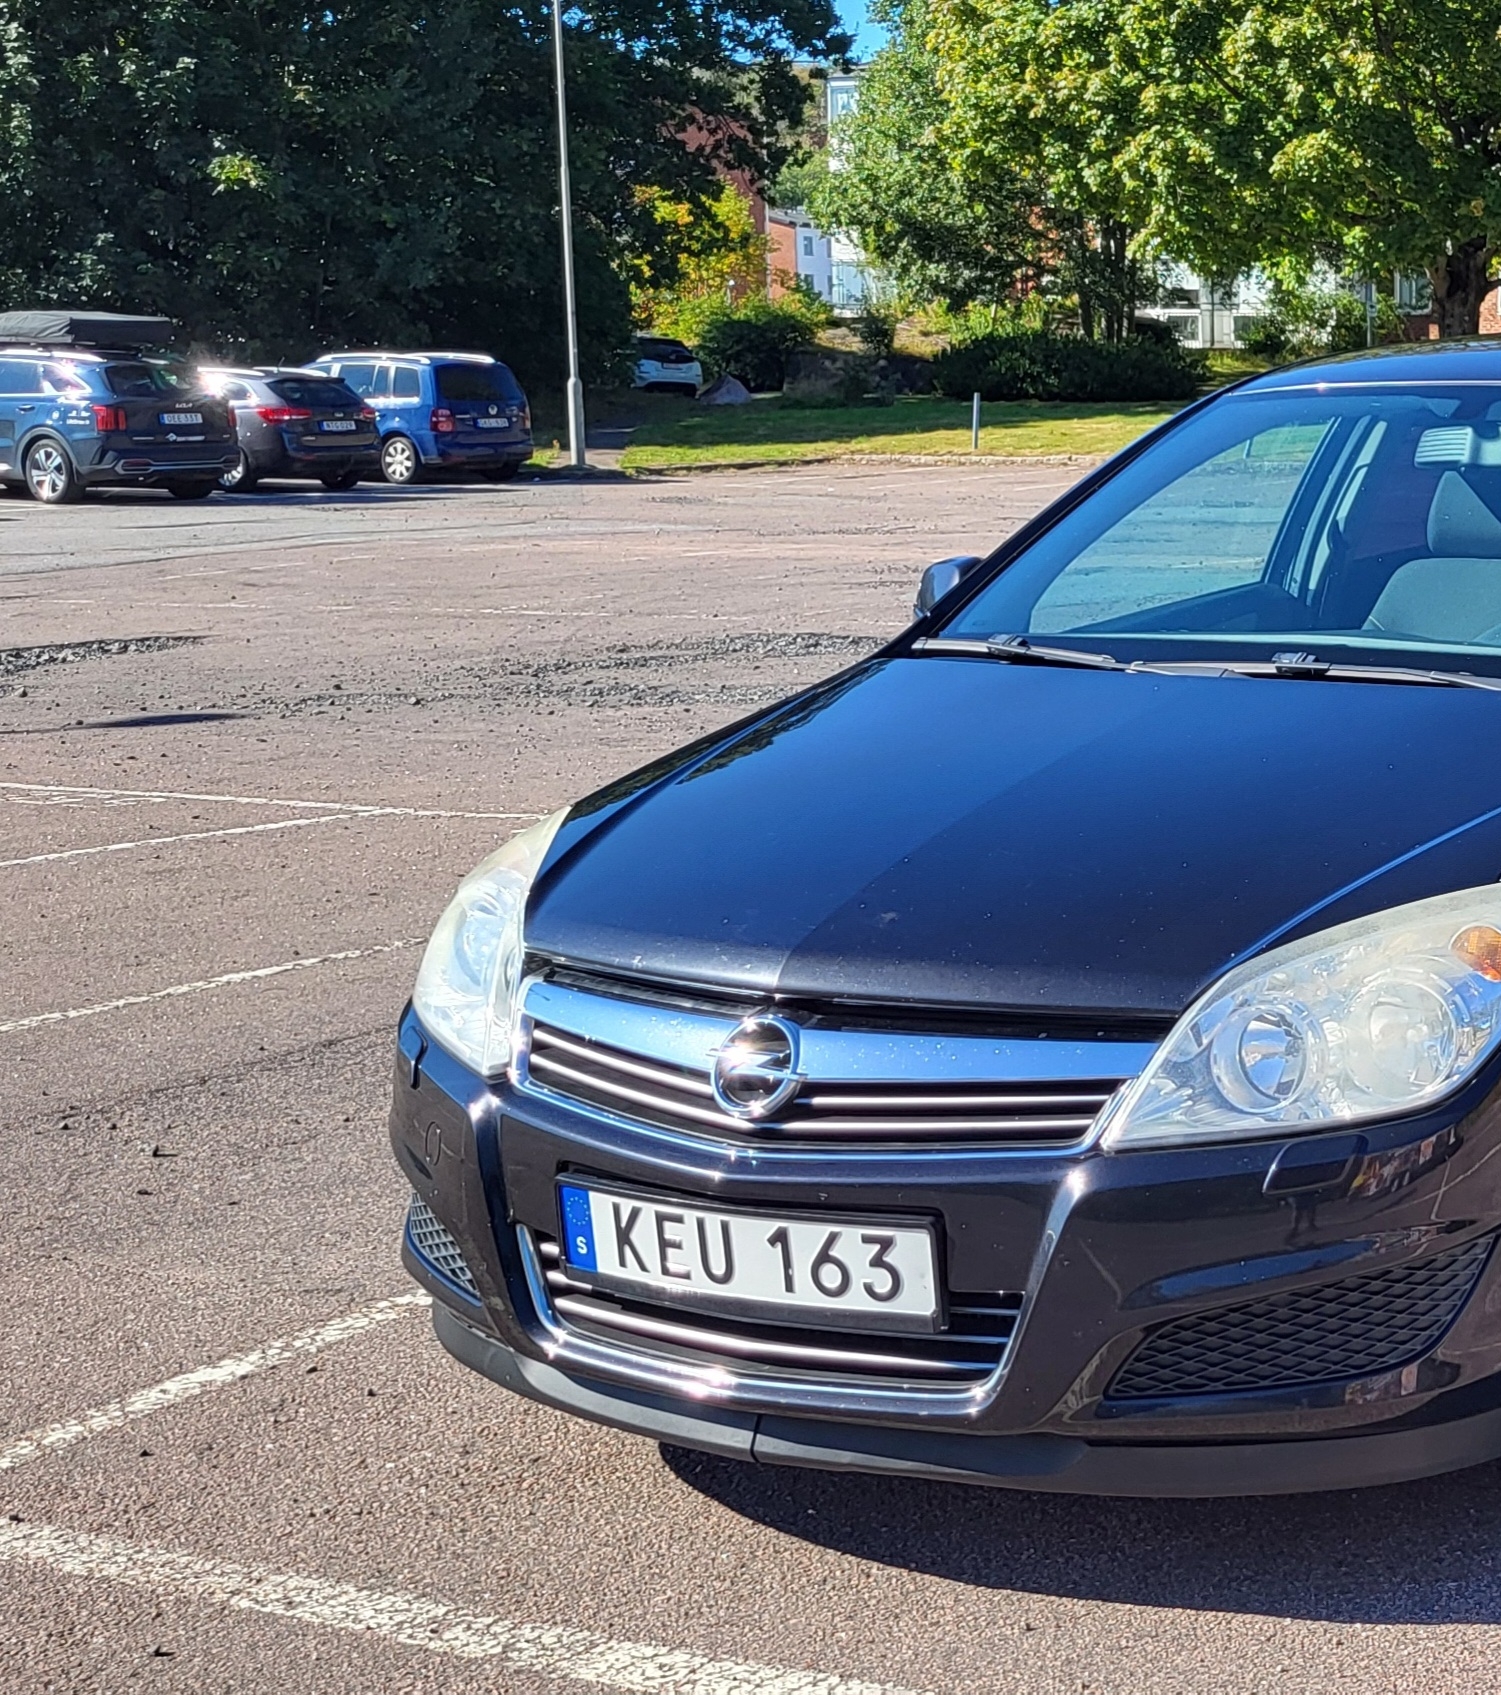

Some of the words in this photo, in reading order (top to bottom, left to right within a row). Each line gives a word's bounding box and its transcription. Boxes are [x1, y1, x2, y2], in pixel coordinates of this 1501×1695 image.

[576, 1236, 588, 1255] S
[611, 1201, 735, 1286] KEU
[766, 1225, 905, 1303] 163
